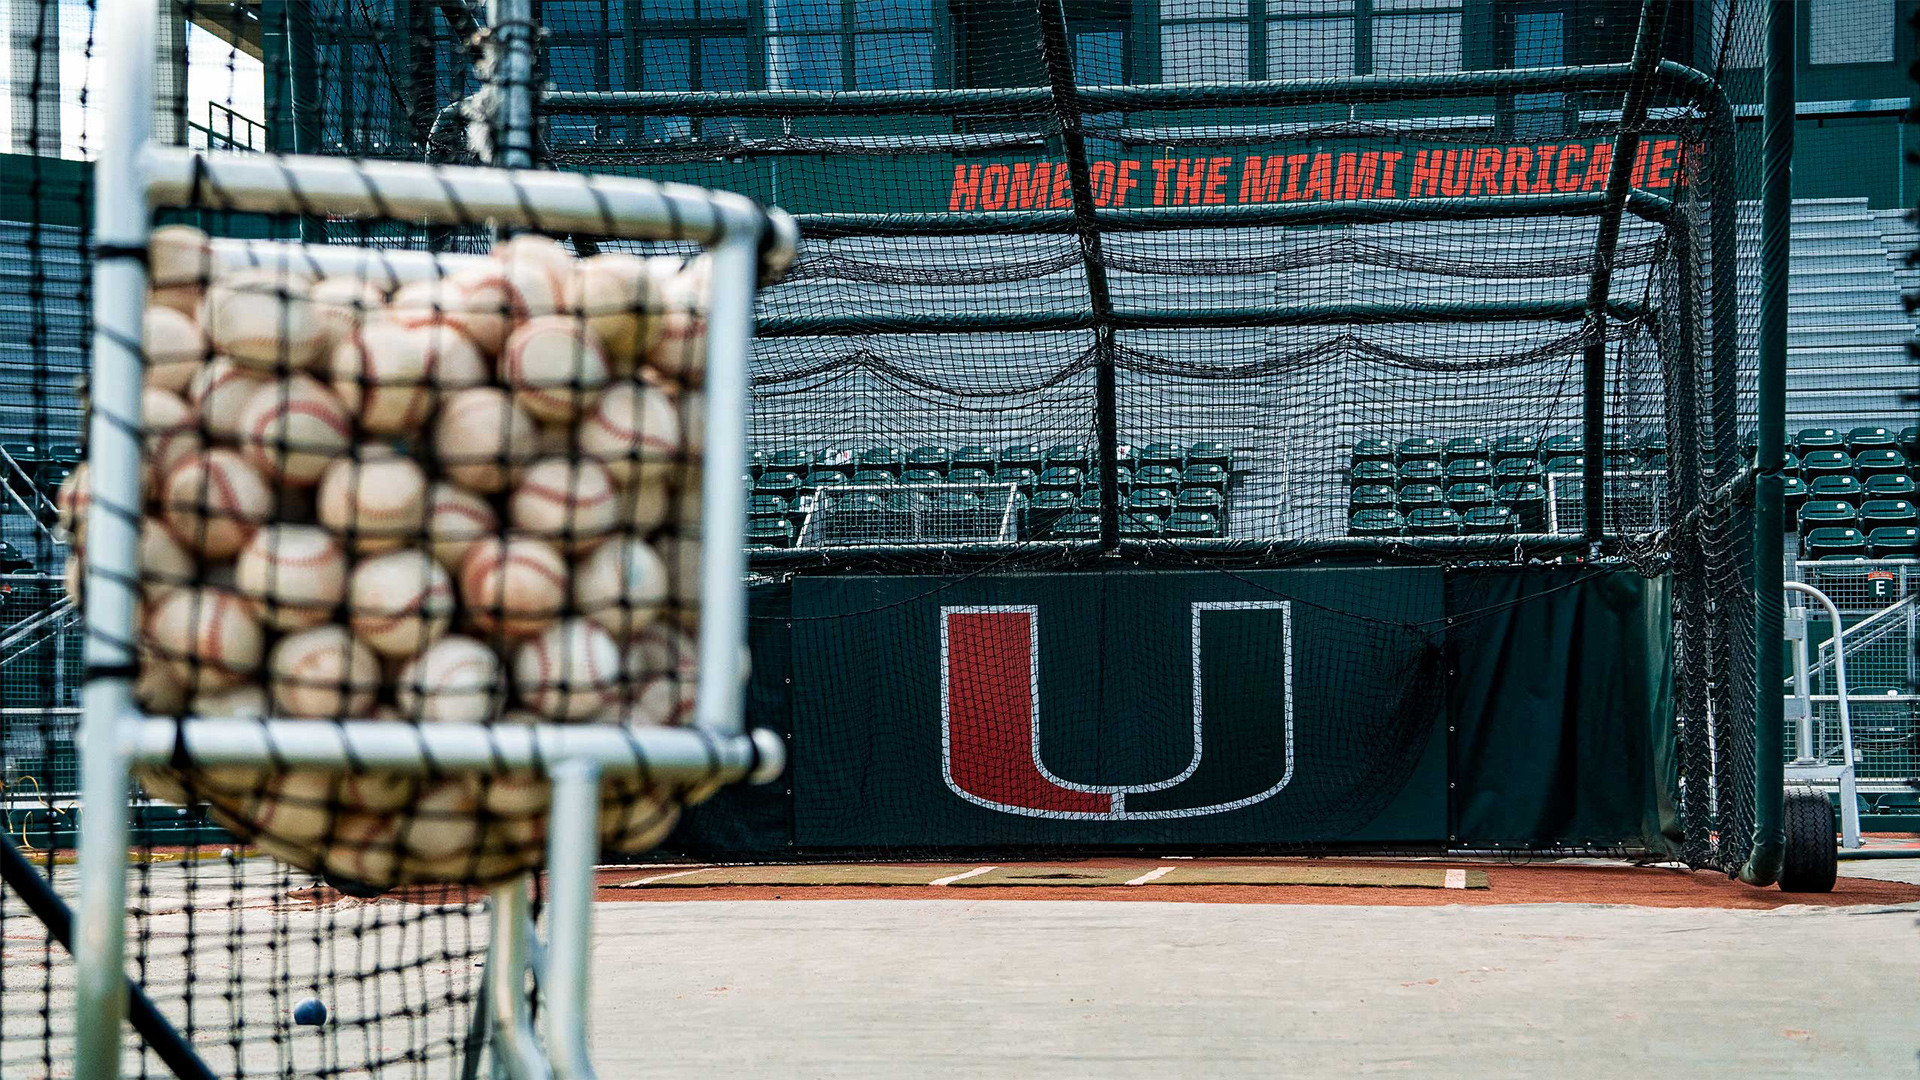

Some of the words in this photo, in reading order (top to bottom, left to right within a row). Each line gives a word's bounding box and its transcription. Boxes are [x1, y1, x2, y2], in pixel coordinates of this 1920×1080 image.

[950, 162, 1071, 210] HOME
[1090, 160, 1140, 207] OF
[1150, 156, 1231, 205] THE
[1238, 152, 1402, 202] MIAMI
[940, 600, 1294, 821] U
